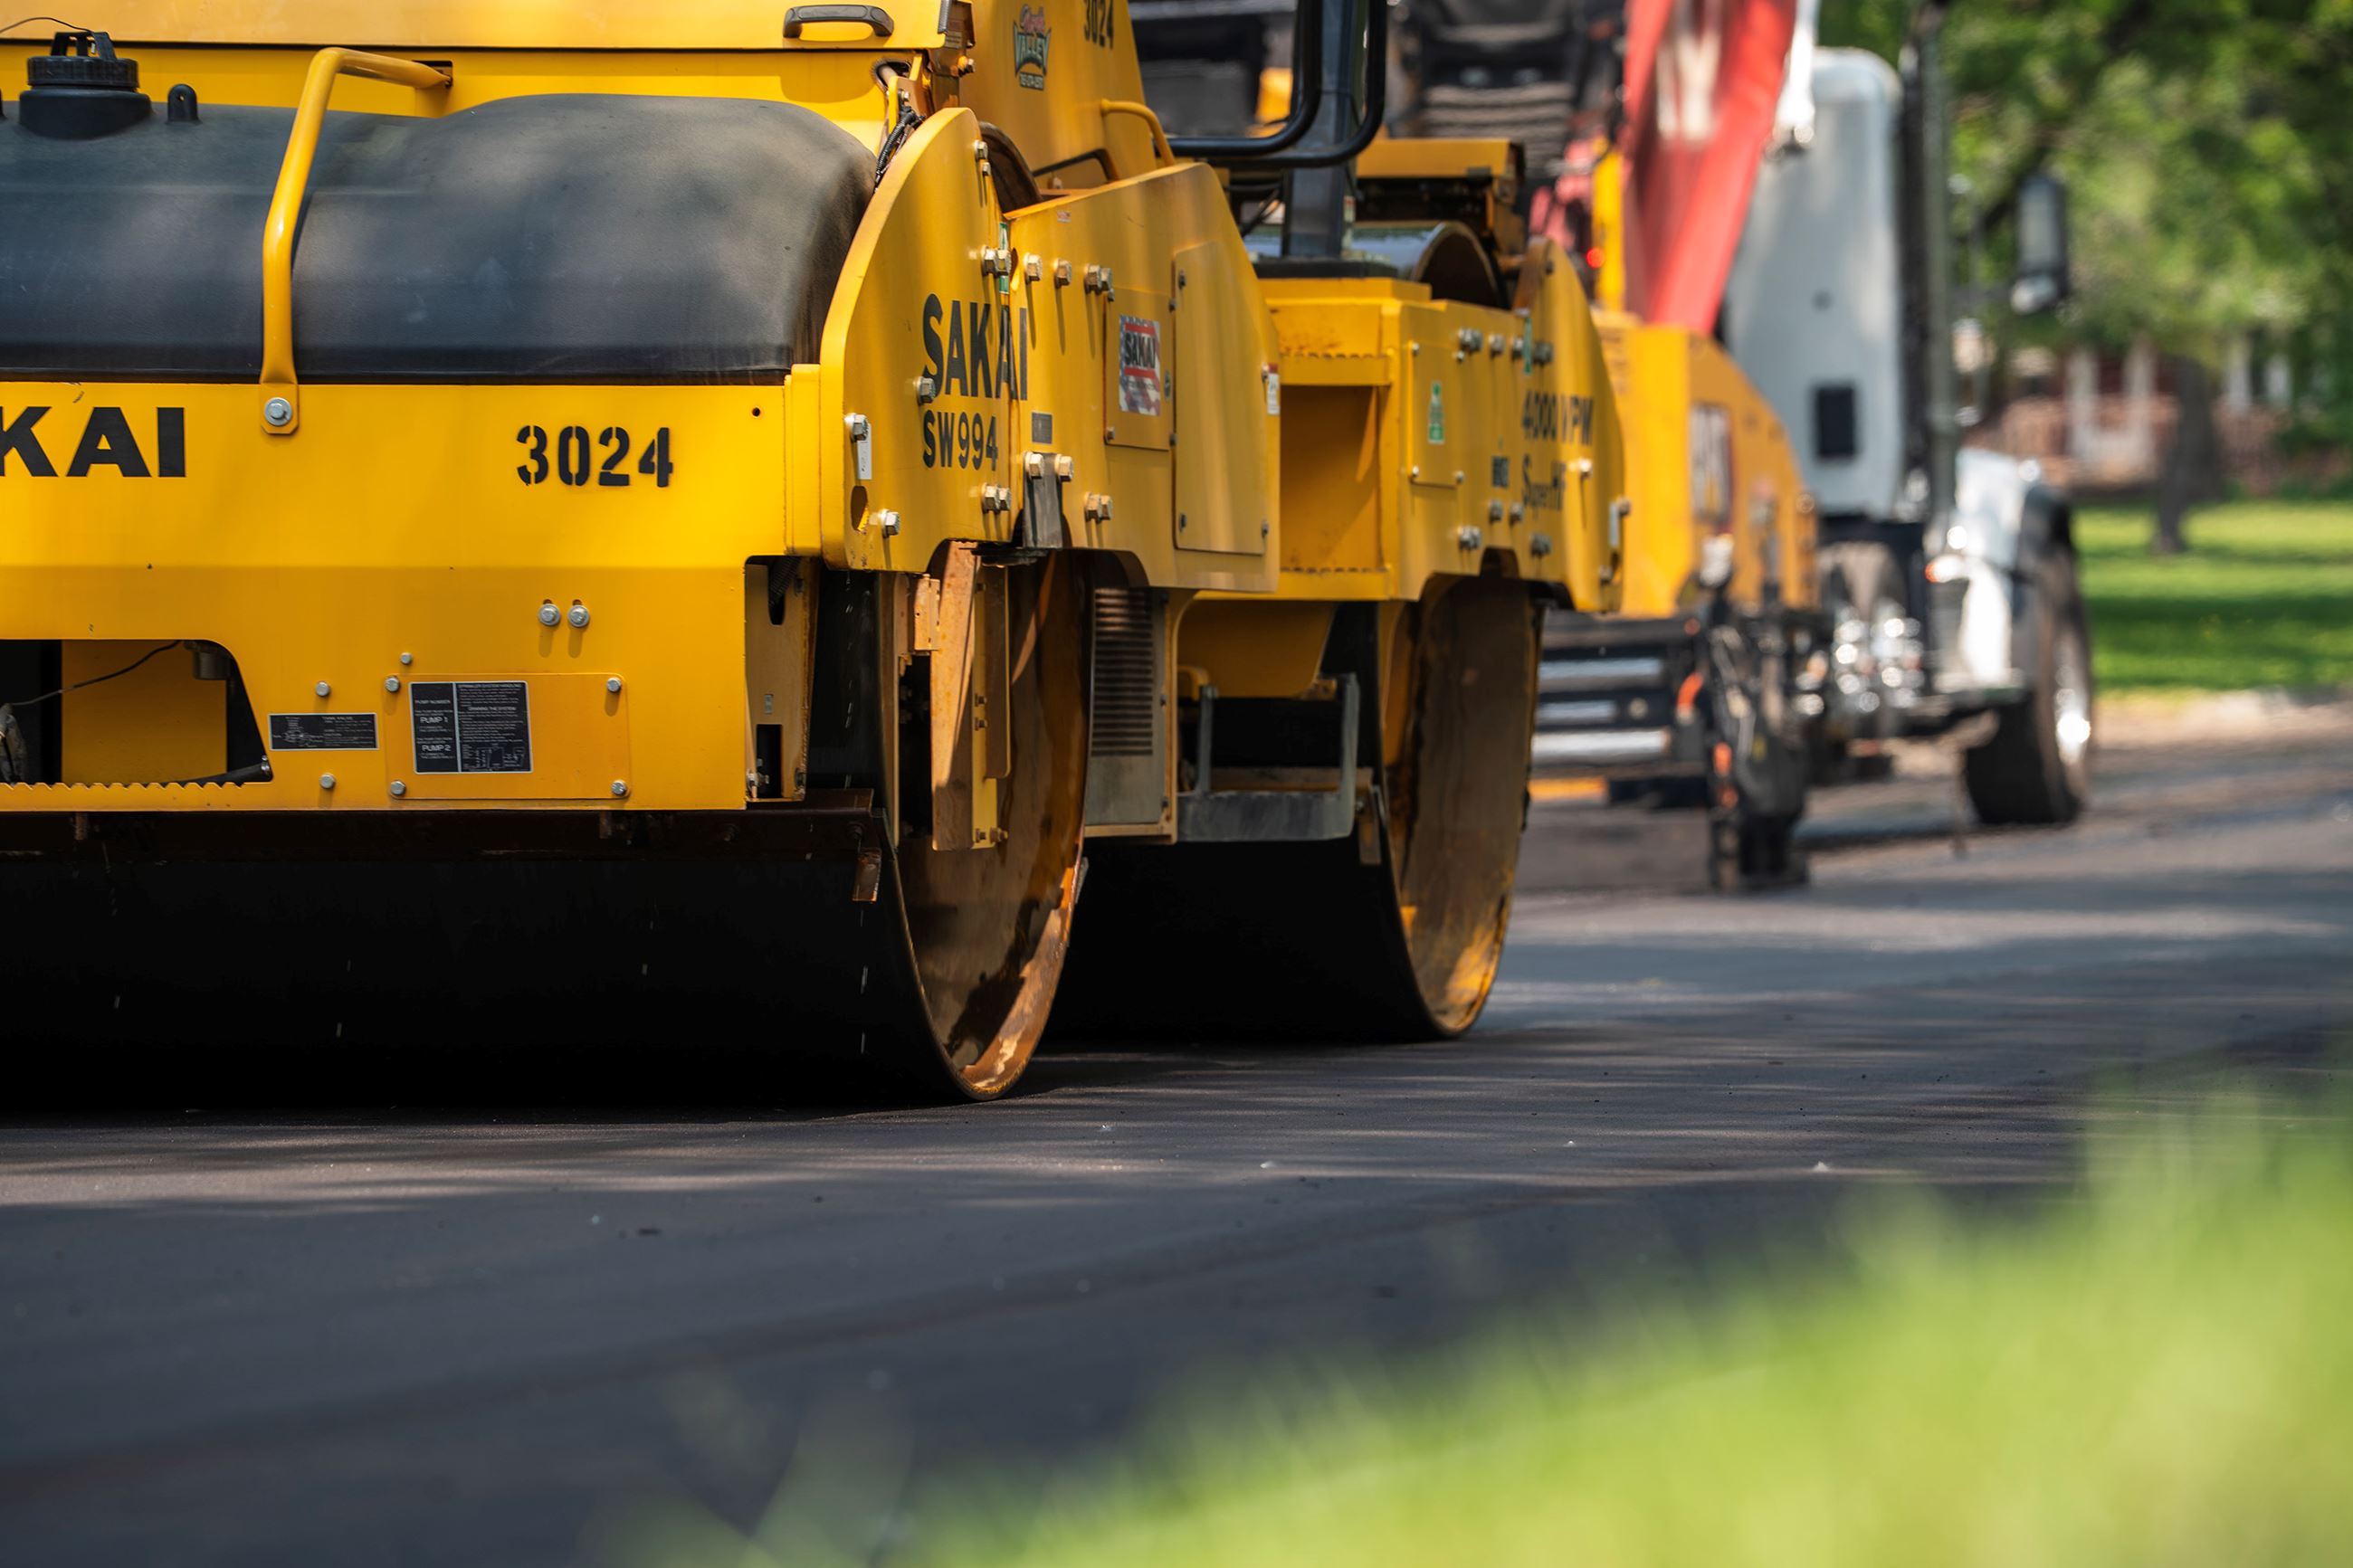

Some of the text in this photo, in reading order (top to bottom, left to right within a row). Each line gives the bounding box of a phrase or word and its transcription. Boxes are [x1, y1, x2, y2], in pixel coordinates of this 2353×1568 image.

[1013, 20, 1052, 77] VALLEY
[1084, 0, 1114, 50] 3024
[922, 293, 1028, 401] SAKAI
[1124, 332, 1156, 369] SAKAI
[0, 406, 186, 477] KAI
[922, 410, 998, 471] SW994
[1522, 390, 1558, 441] 4000
[517, 425, 673, 488] 3024
